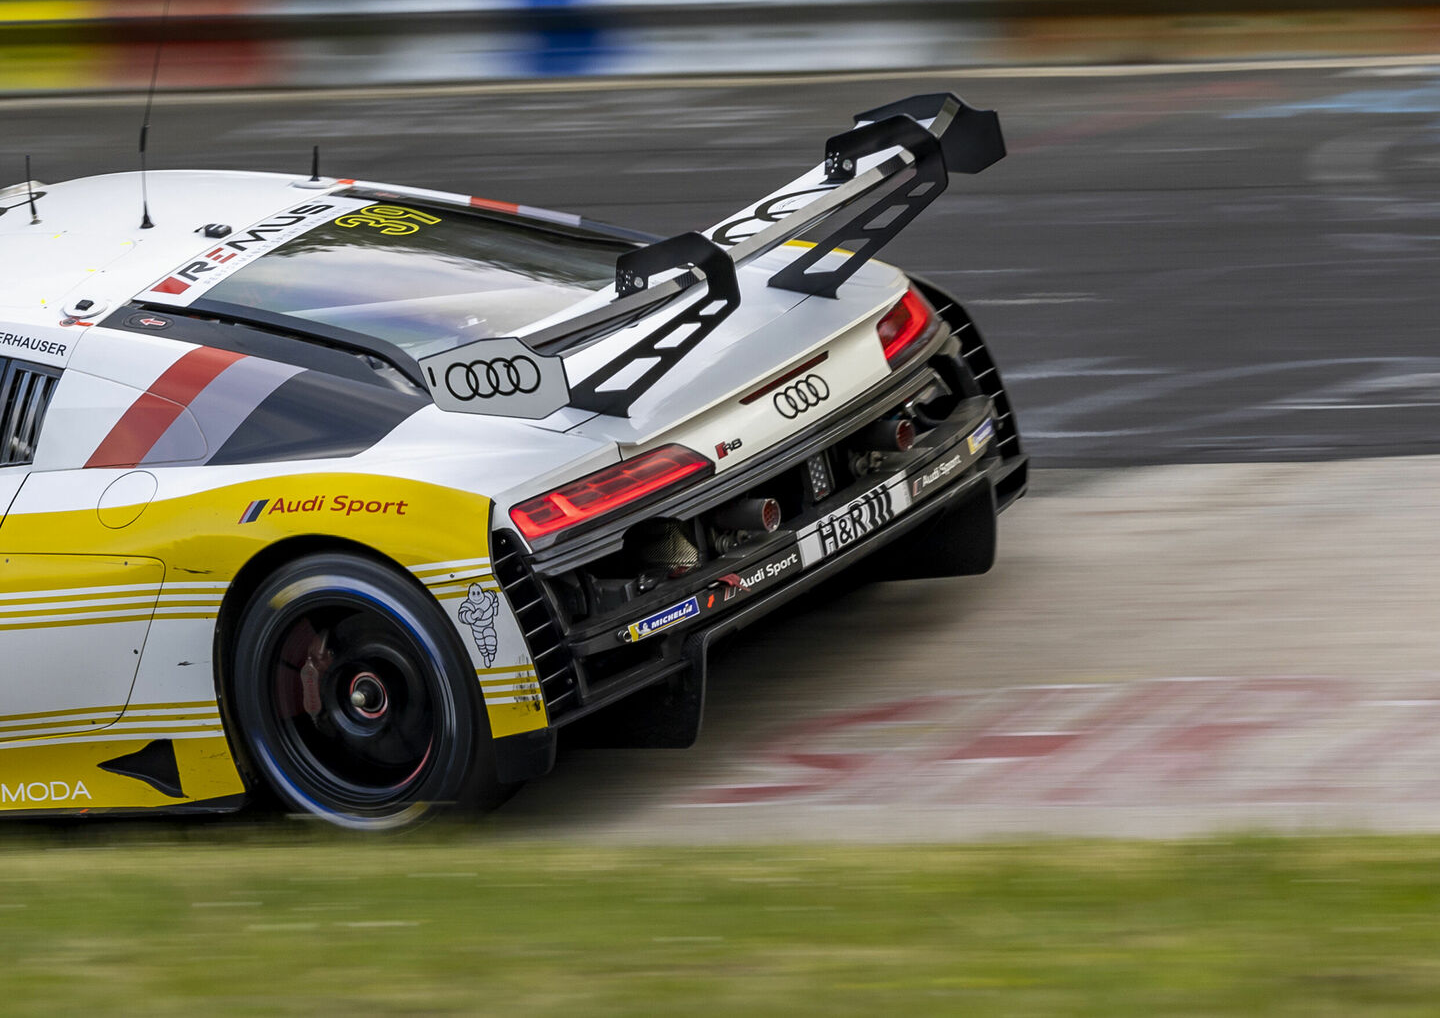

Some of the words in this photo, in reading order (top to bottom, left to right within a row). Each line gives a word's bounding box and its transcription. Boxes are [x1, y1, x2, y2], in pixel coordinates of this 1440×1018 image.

[334, 204, 442, 235] 39
[177, 204, 335, 281] REMUS
[720, 437, 743, 455] R8
[268, 496, 325, 515] Audi
[330, 495, 408, 516] Sport
[739, 568, 765, 591] Audi
[765, 553, 798, 576] Sport
[651, 603, 693, 629] MICHELIN
[0, 780, 92, 803] MODA
